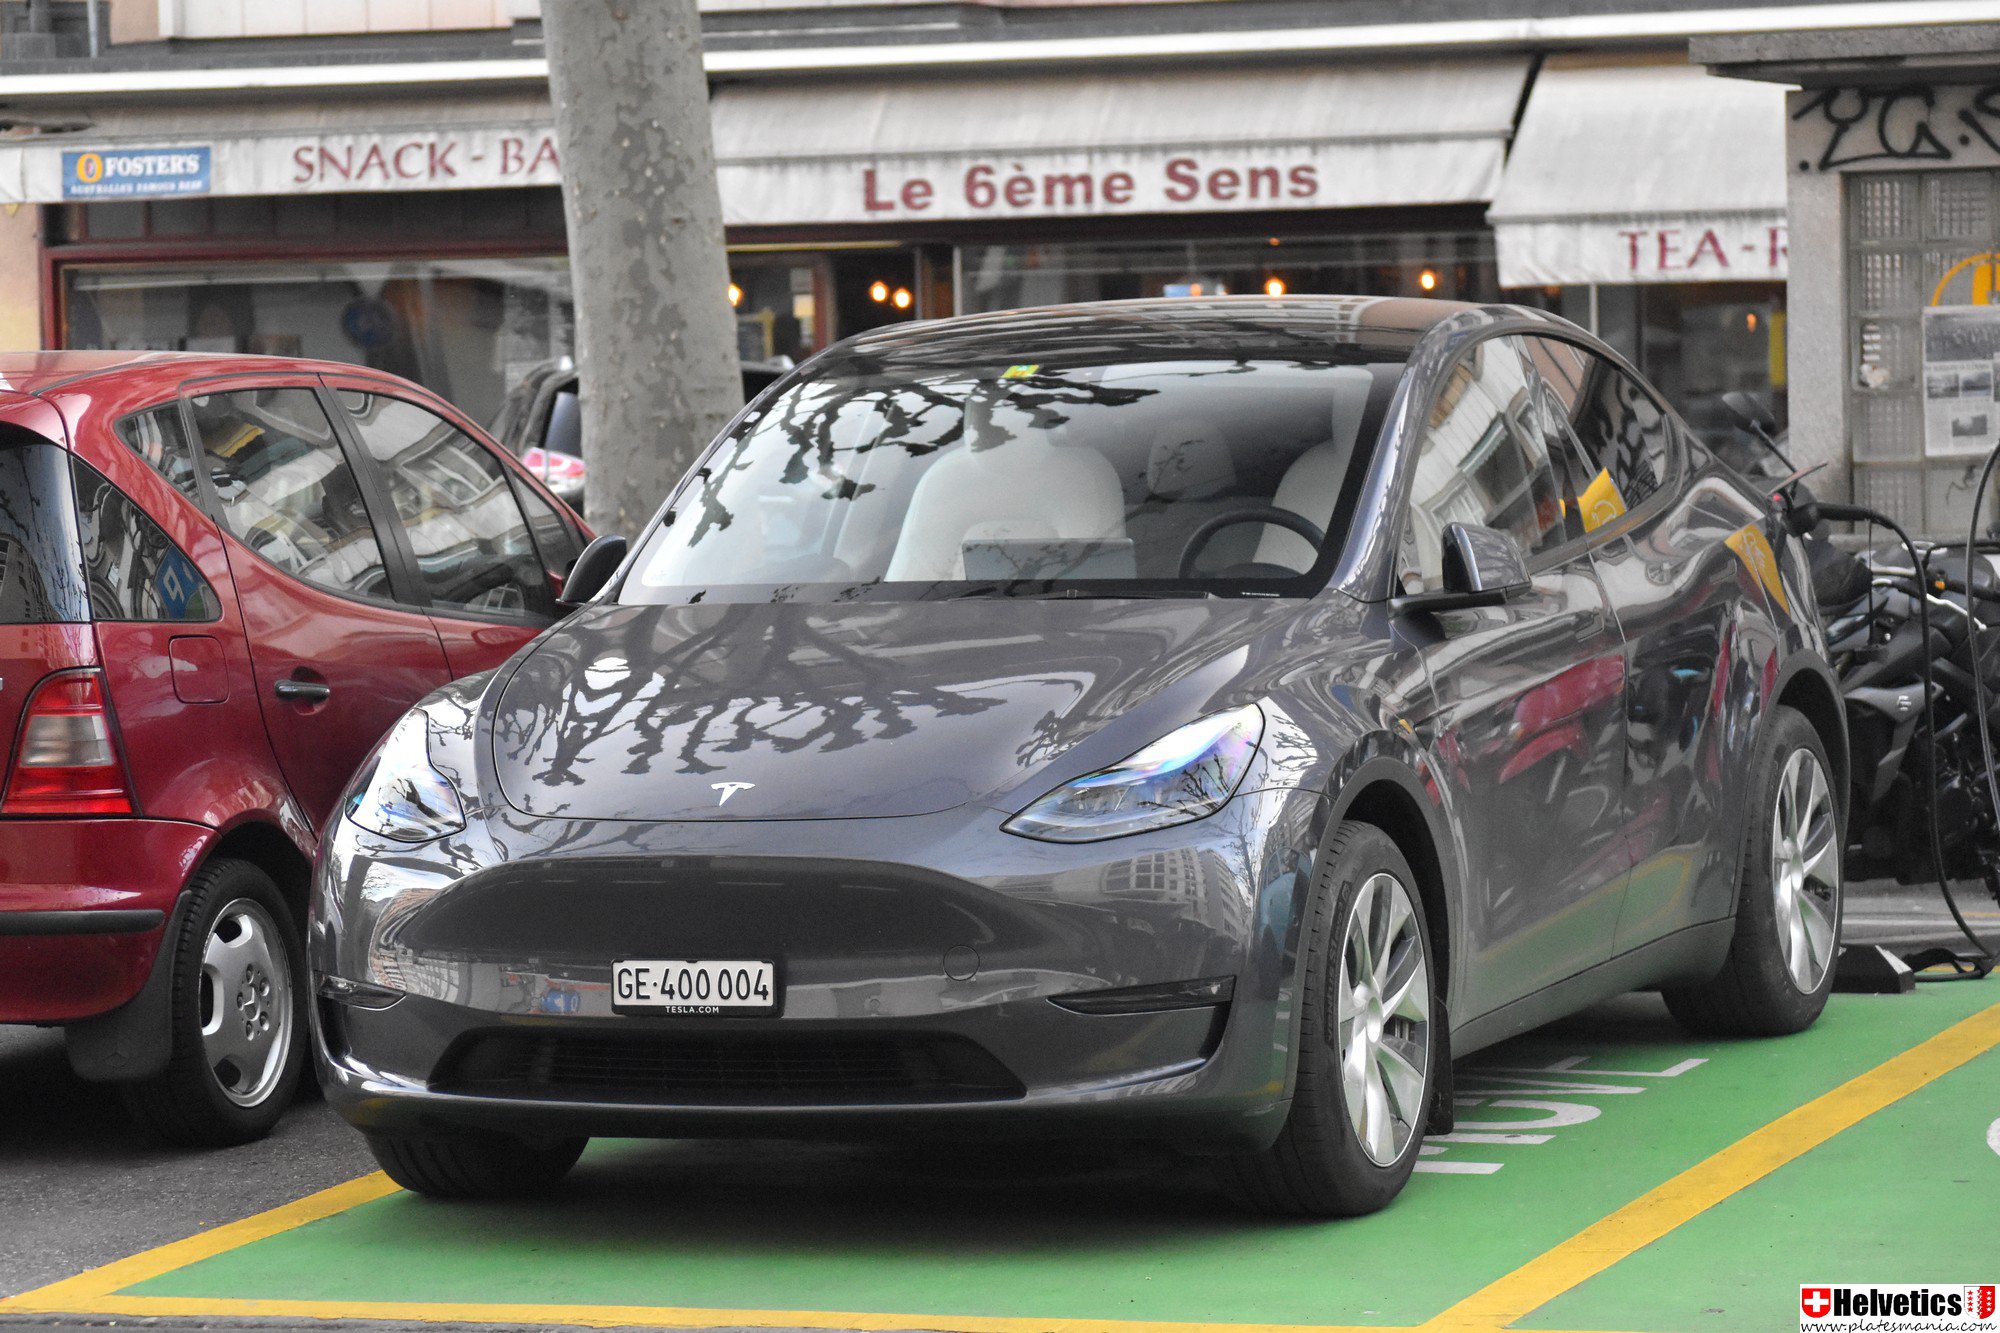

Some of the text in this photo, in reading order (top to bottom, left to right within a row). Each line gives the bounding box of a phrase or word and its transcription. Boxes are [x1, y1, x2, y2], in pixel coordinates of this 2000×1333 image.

[293, 141, 457, 184] SNACK
[863, 158, 1320, 212] Le 6ème Sens
[1618, 228, 1729, 271] TEA
[717, 968, 769, 1001] 004
[665, 1005, 720, 1014] TESLA.COM
